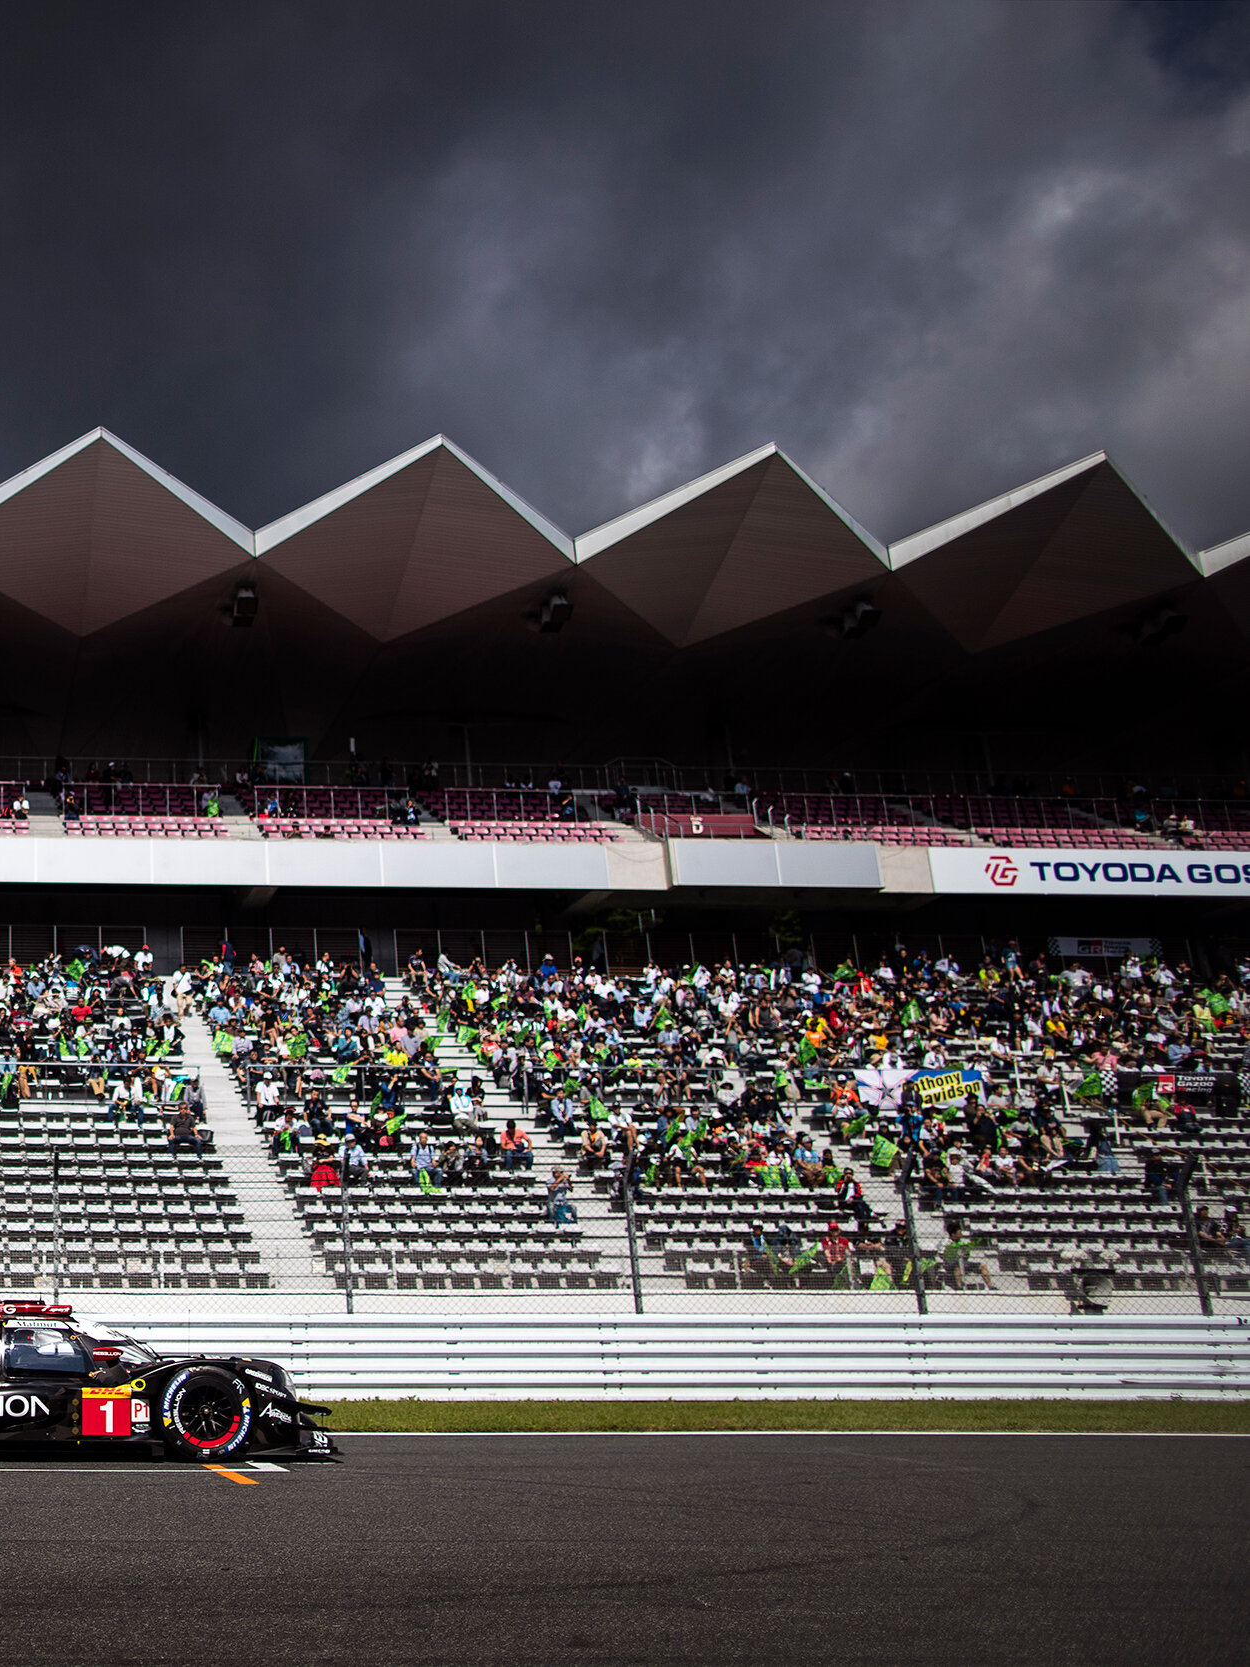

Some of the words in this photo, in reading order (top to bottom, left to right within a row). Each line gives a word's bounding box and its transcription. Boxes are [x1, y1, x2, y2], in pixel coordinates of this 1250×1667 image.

[1030, 861, 1182, 883] TOYODA
[163, 1373, 187, 1410] MICHELIN
[99, 1400, 114, 1433] 1
[134, 1402, 148, 1418] P1
[172, 1387, 187, 1435] REBELLION
[227, 1414, 250, 1451] MICHELIN
